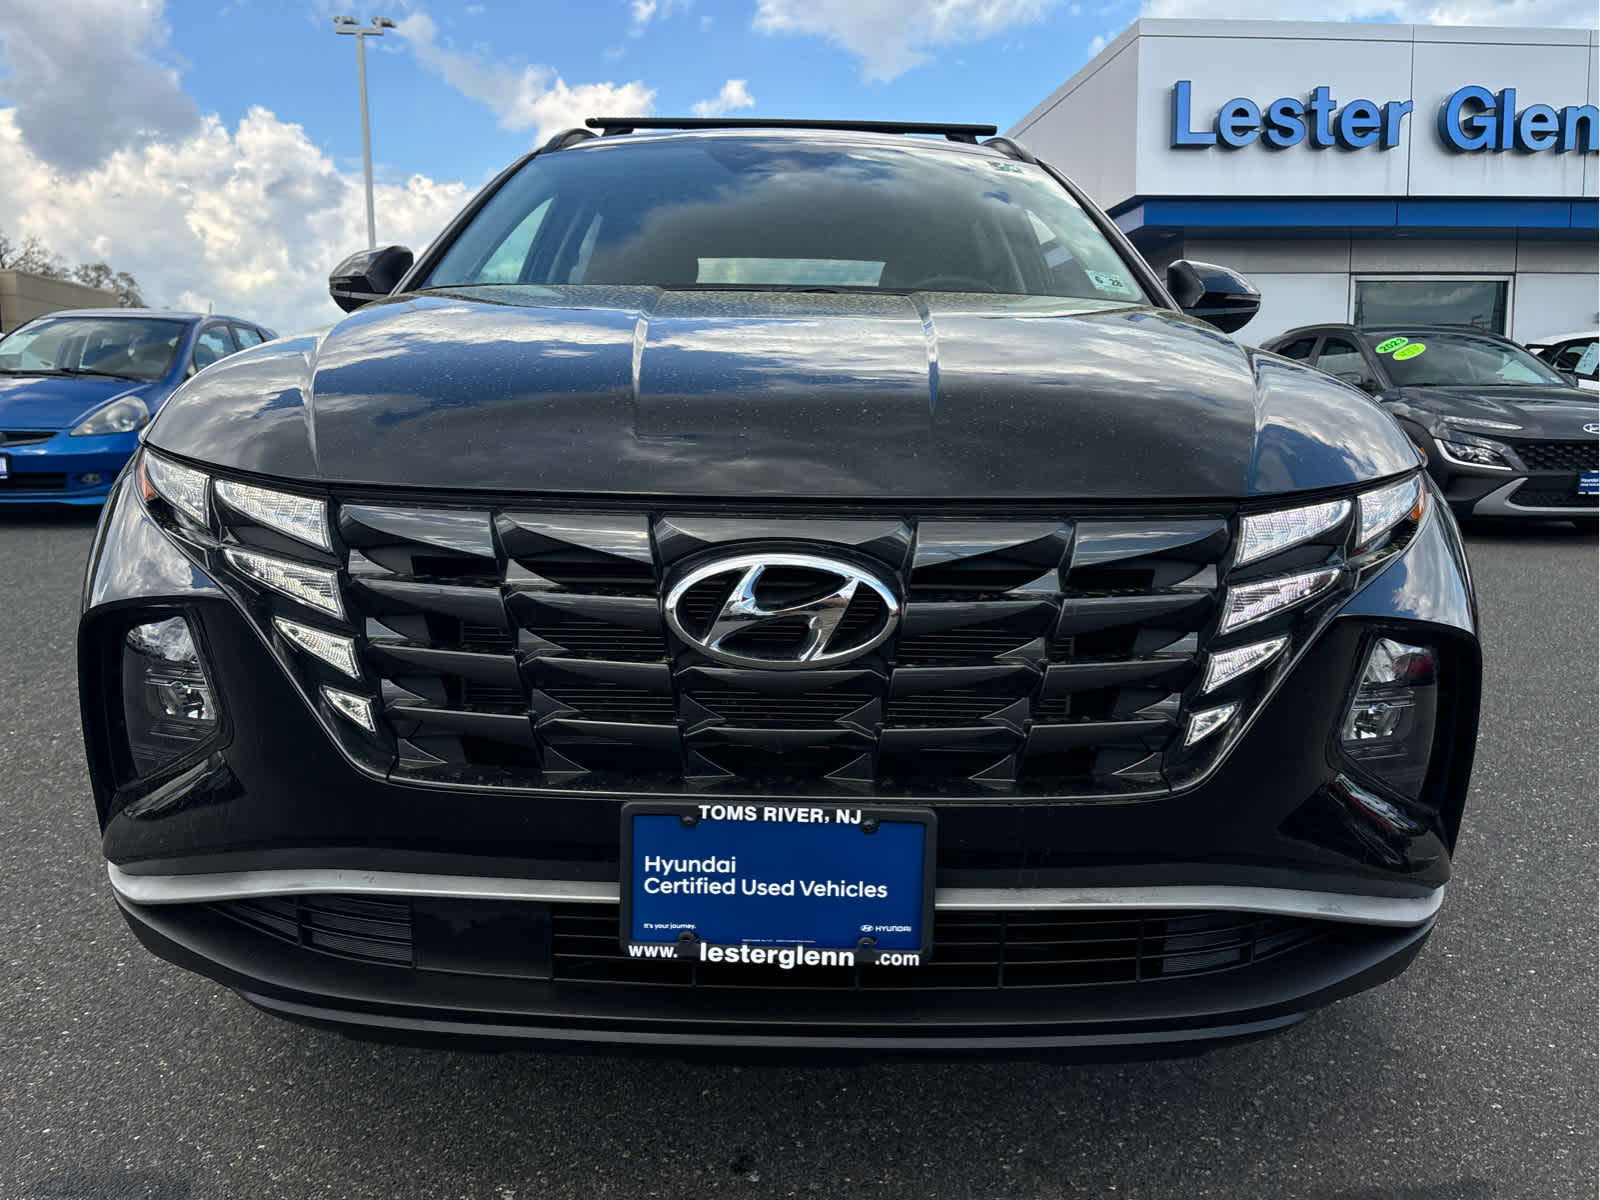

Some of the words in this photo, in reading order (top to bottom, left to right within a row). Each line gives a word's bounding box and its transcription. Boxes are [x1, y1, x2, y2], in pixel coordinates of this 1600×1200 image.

[1171, 80, 1414, 149] Lester
[698, 805, 757, 821] TOMS
[764, 807, 829, 823] RIVER,
[836, 809, 861, 824] NJ
[645, 856, 736, 875] Hyundai
[644, 877, 735, 895] Certified
[742, 879, 794, 896] Used
[800, 880, 888, 898] Vehicles
[629, 945, 678, 958] www.
[700, 942, 854, 969] lesterglenn
[875, 954, 919, 966] .com
